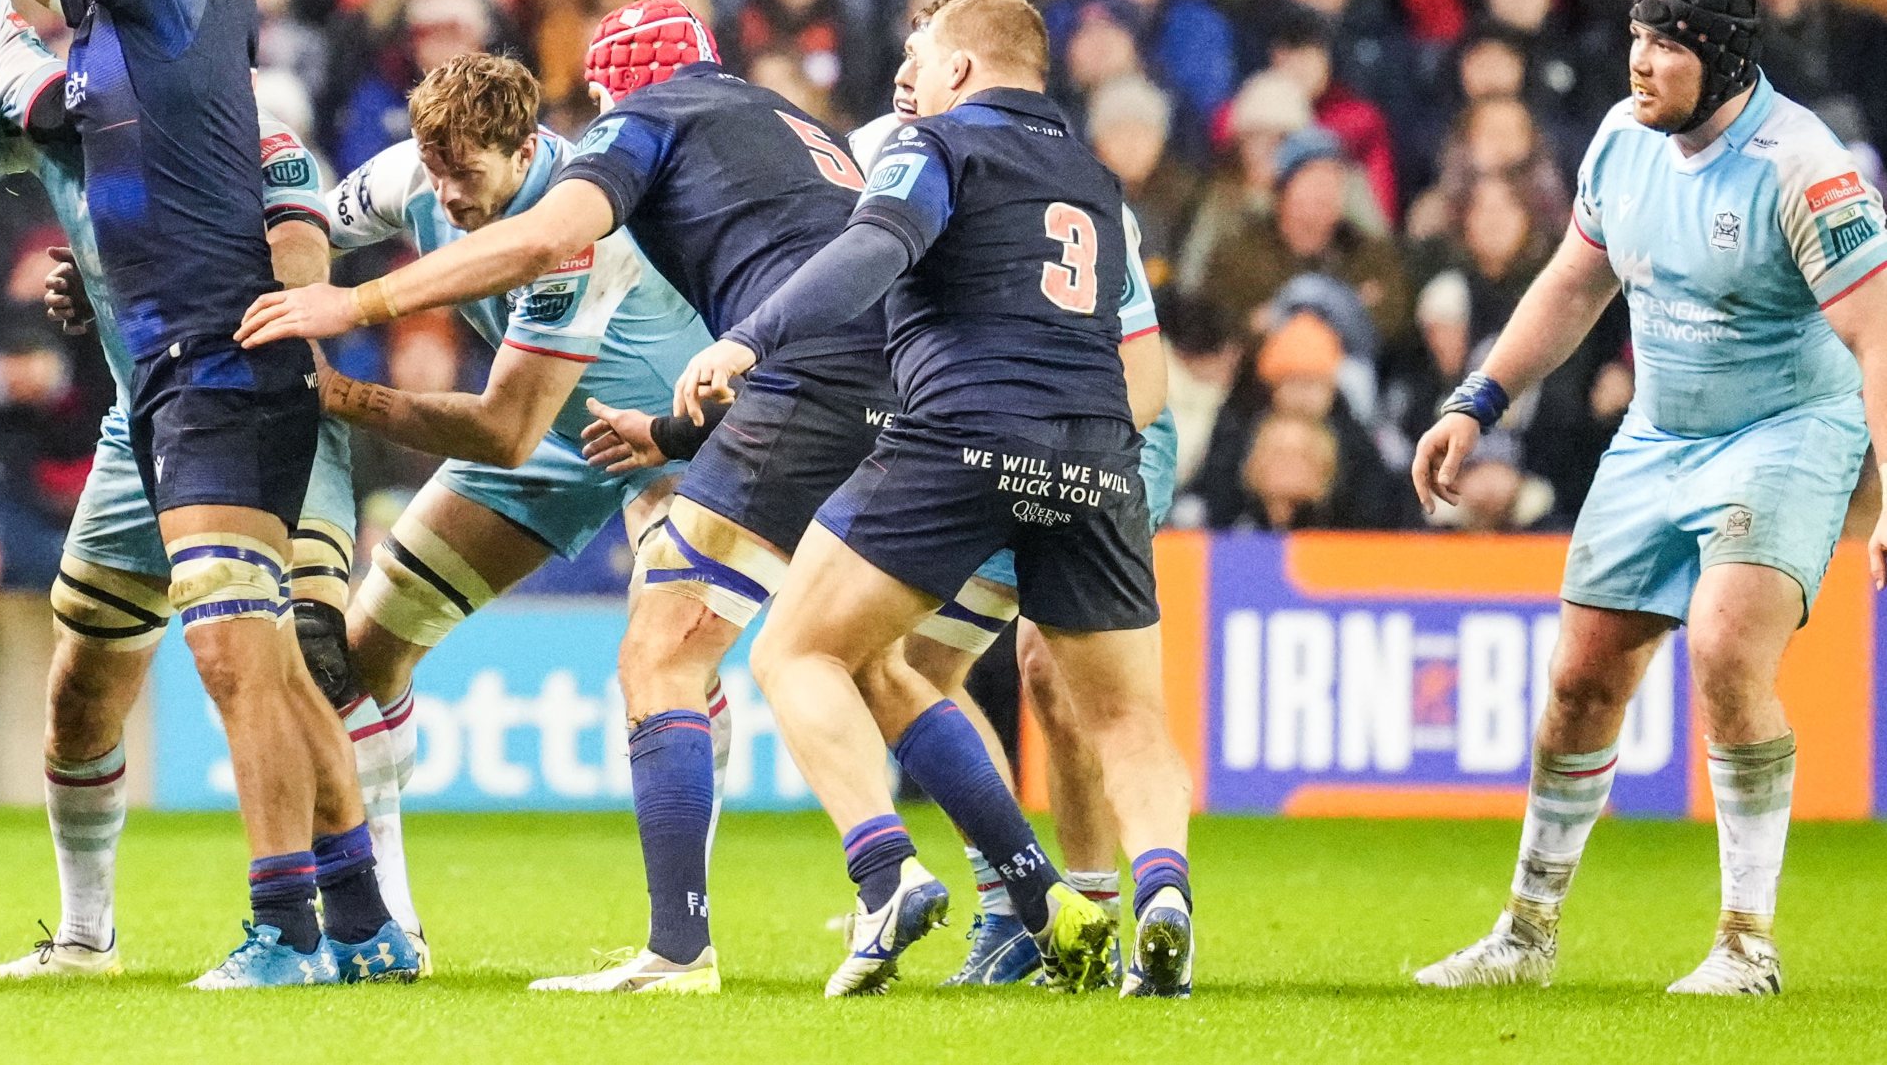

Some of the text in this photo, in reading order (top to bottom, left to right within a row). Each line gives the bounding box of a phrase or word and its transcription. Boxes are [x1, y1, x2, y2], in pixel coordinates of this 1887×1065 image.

[773, 109, 866, 192] 5
[901, 140, 927, 148] Vardy
[1811, 184, 1862, 209] brillband
[1041, 201, 1098, 314] 3
[865, 407, 896, 428] WE
[963, 448, 1132, 495] WE WILL, WE WILL
[997, 475, 1103, 508] RUCK YOU
[1012, 500, 1072, 524] QUEENS
[1022, 514, 1054, 527] ARMS
